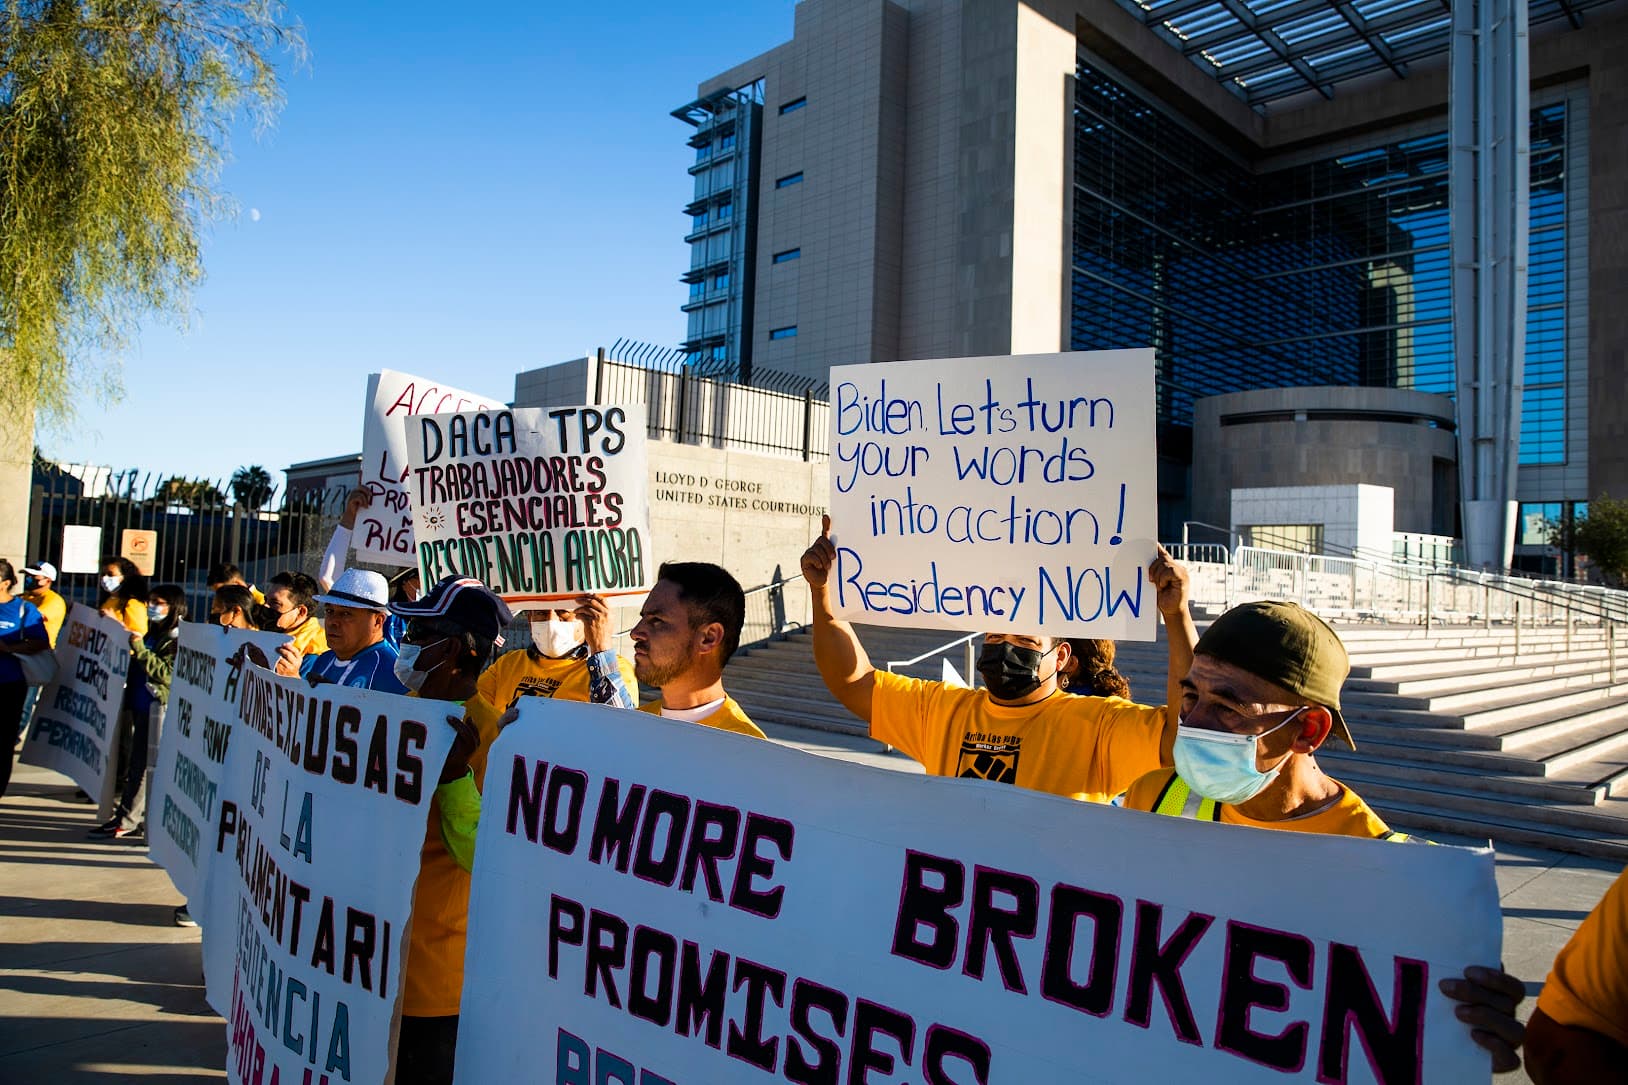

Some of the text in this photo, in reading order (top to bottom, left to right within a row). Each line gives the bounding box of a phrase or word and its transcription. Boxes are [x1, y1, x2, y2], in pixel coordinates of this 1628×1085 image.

[420, 410, 517, 464] DACA
[548, 406, 626, 456] TPS
[937, 378, 1017, 436] Let's
[1017, 377, 1114, 433] turn
[414, 455, 607, 506] TRABAJADORES
[656, 471, 763, 494] LLOYD D GEORGE
[836, 436, 1095, 493] your words
[456, 492, 624, 538] ESENCIALES
[656, 489, 826, 517] UNITED STATES COURTHOUSE
[870, 486, 938, 537] into
[419, 527, 645, 598] RESIDENCIA AHORA
[836, 547, 1143, 625] Residency NOW
[274, 683, 428, 806] EXCUSAS
[251, 750, 313, 864] DE LA
[505, 754, 1429, 1085] NO MORE BROKEN
[548, 892, 993, 1085] PROMISES
